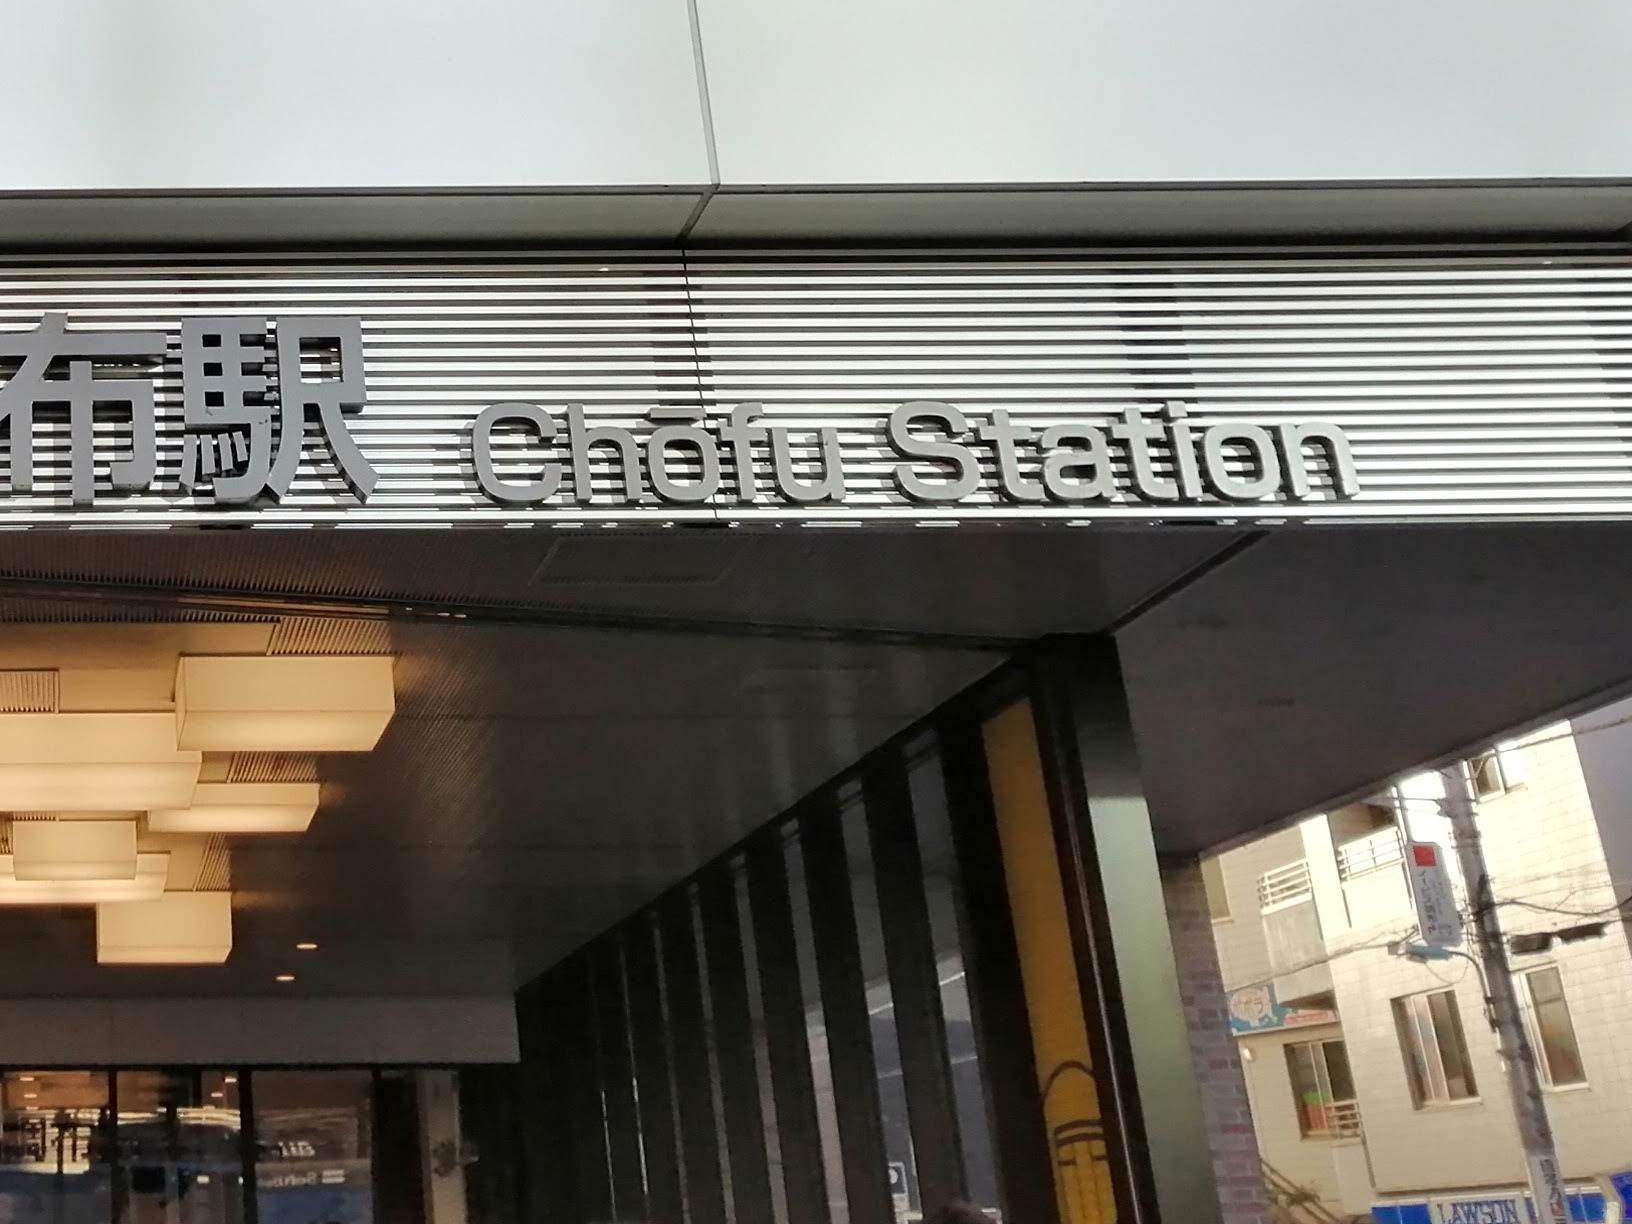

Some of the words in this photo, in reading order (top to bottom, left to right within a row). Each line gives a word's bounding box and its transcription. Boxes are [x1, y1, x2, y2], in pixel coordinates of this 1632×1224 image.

[470, 401, 848, 504] Chōfu
[886, 401, 1362, 503] Station
[1435, 1199, 1522, 1224] LAWSON
